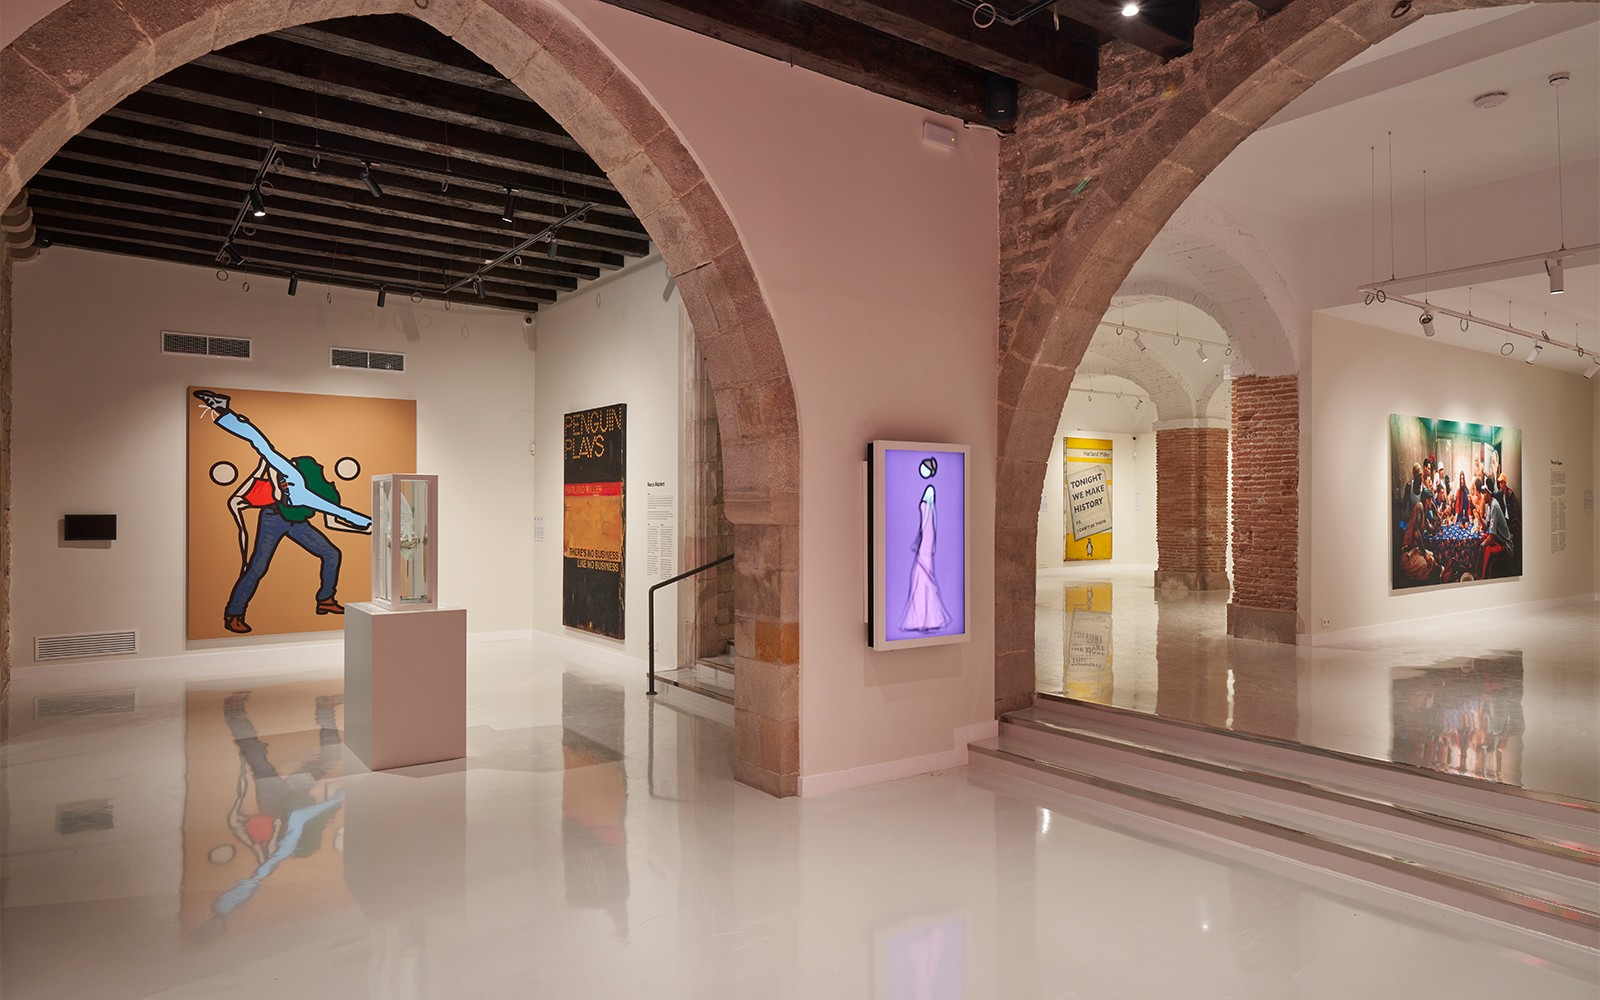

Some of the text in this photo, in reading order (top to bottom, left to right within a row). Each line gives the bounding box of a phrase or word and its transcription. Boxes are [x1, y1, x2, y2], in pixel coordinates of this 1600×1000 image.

[565, 407, 622, 436] PENGUIN
[565, 435, 605, 460] PLAYS
[1070, 473, 1102, 489] TONIGHT
[1072, 485, 1105, 501] WE MAKE
[1074, 497, 1103, 513] HISTORY
[595, 549, 620, 560] BUSINESS
[577, 559, 587, 569] LIKE
[595, 560, 619, 572] BUSINESS
